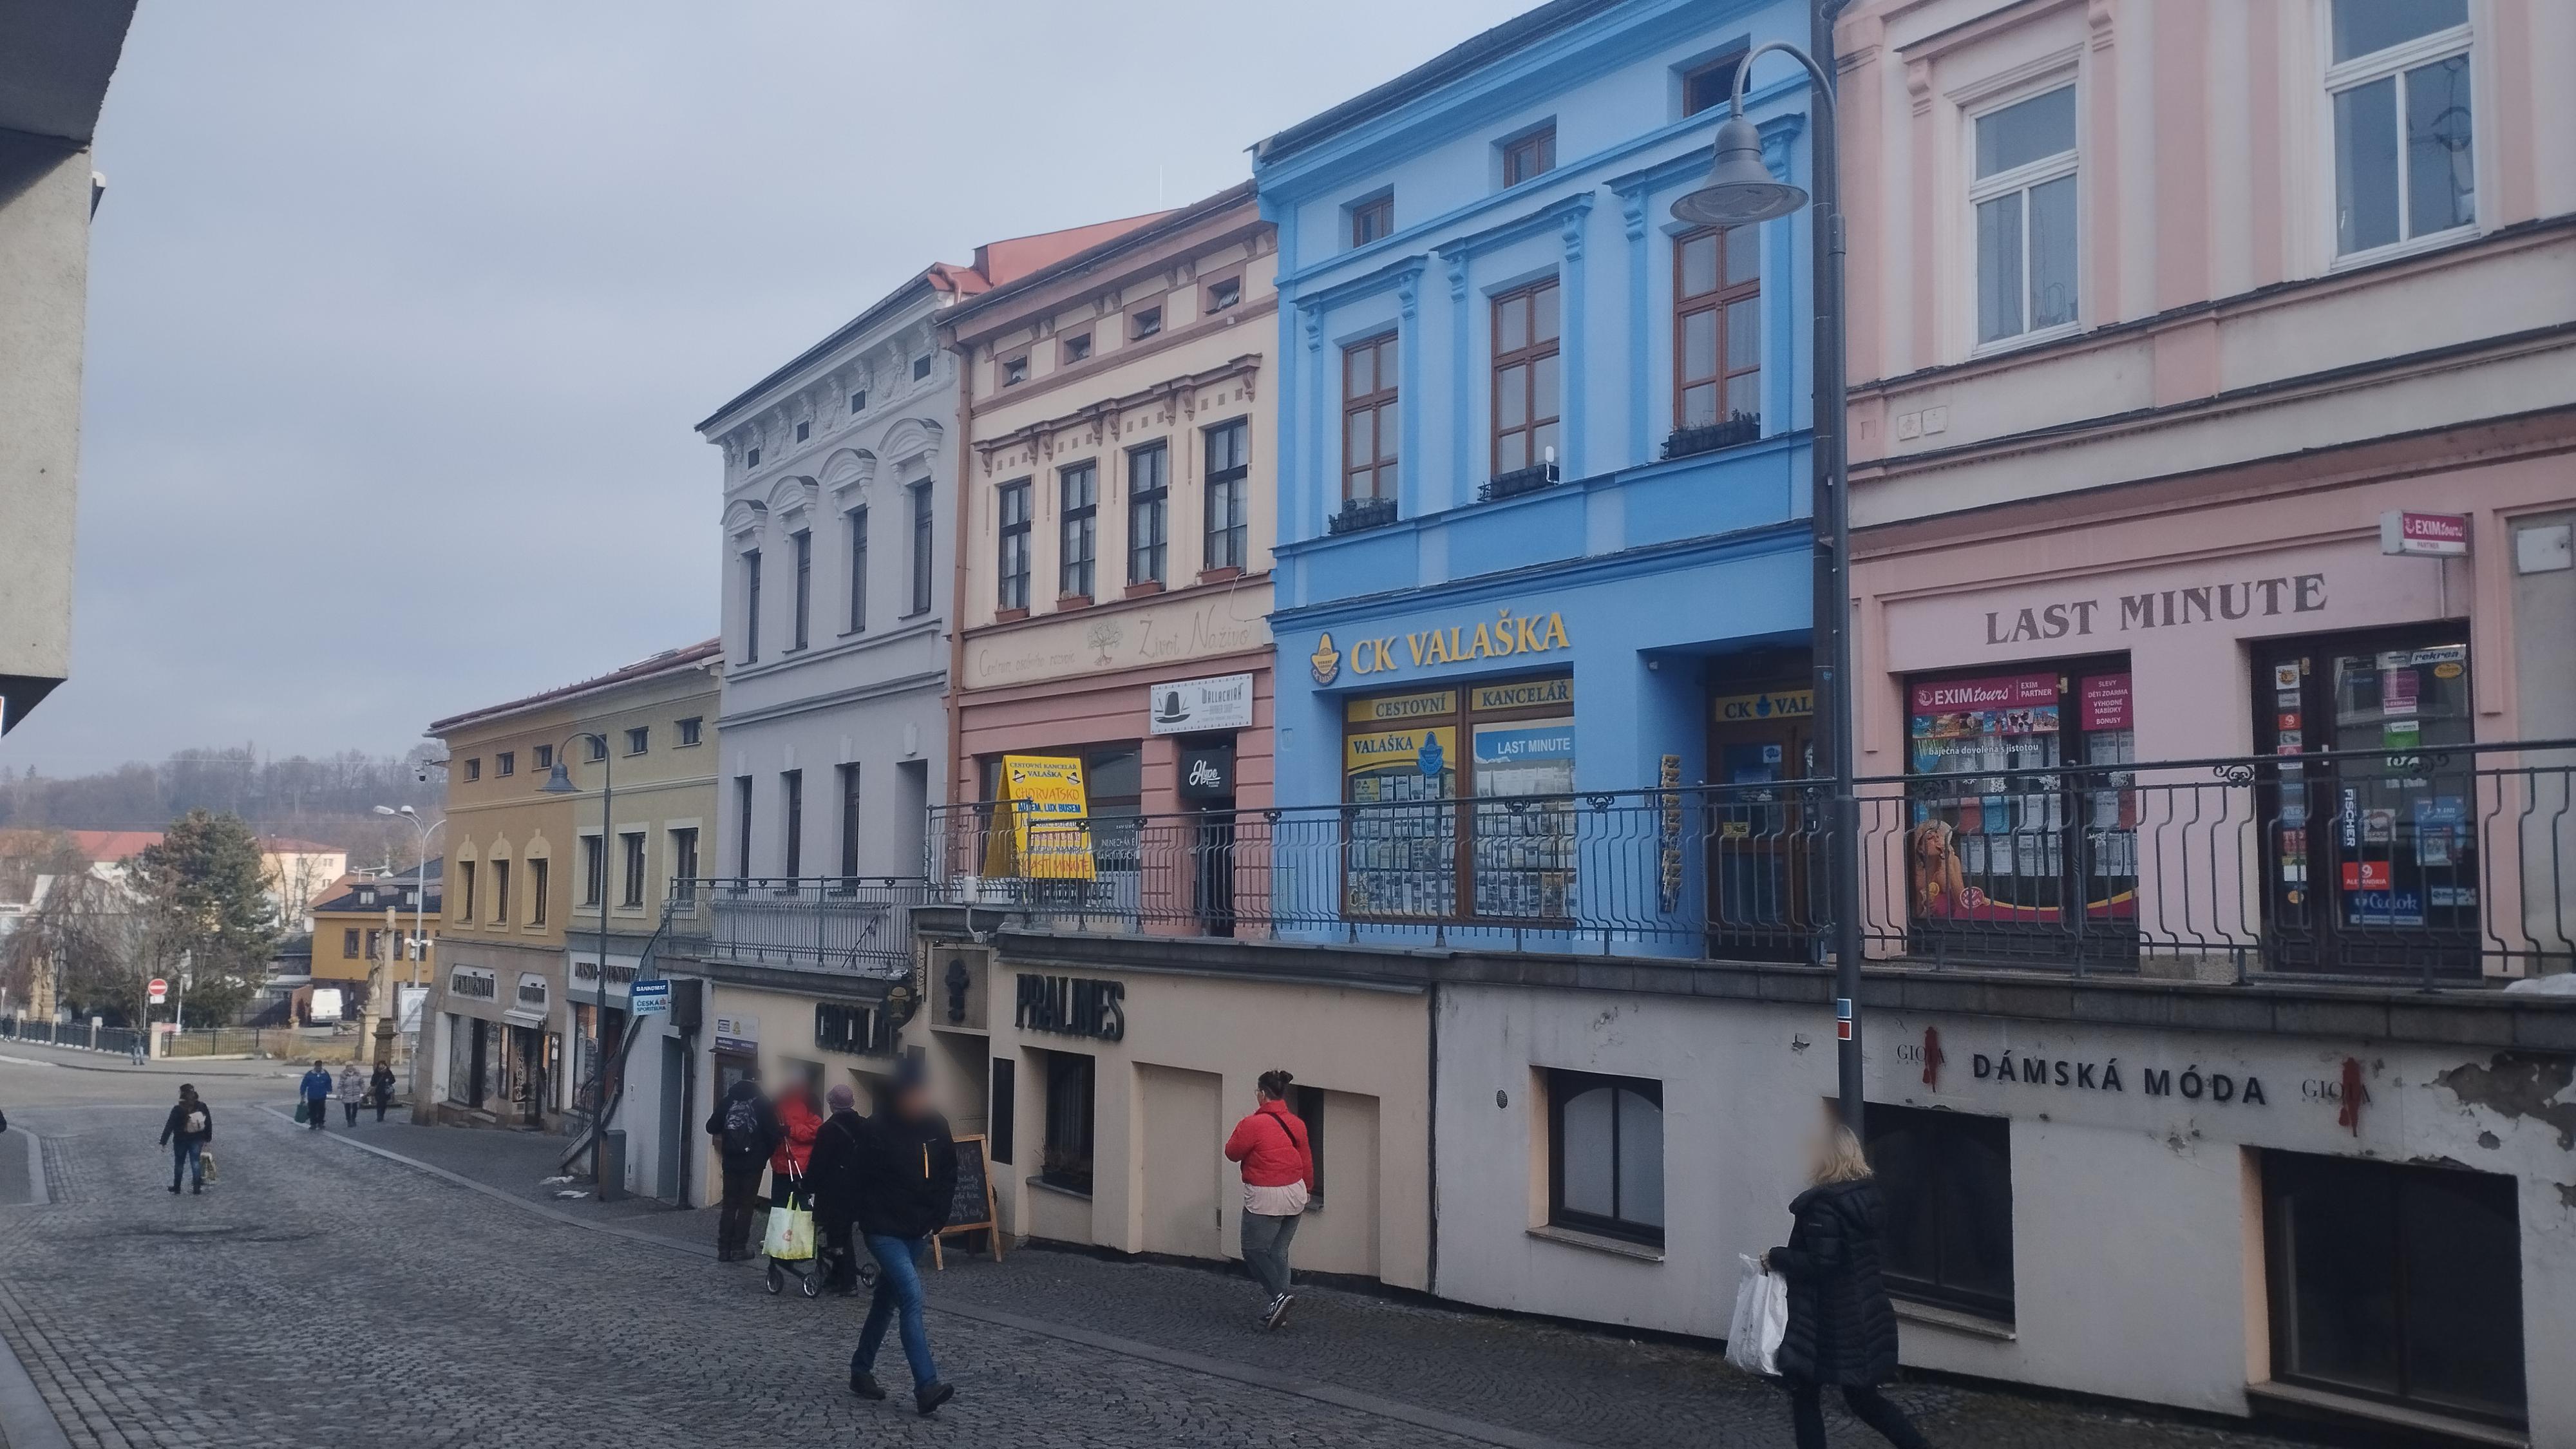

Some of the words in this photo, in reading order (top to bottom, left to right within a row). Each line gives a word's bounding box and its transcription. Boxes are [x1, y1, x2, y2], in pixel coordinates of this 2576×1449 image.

[1985, 600, 2099, 645] LAST
[2119, 573, 2328, 631] MINUTE
[1139, 614, 1180, 658] Život
[1351, 636, 1398, 674] CK
[1406, 608, 1571, 667] VALAŠKA
[1376, 692, 1446, 717] CESTOVNÍ
[1482, 679, 1569, 707] KANCELÁŘ
[1935, 687, 2009, 706] EXIMtours
[2021, 681, 2038, 690] EXIM
[2021, 688, 2052, 698] PARTNER
[2102, 688, 2128, 697] ZDARMA
[1725, 701, 1752, 719] CK
[2095, 706, 2122, 715] NABÍDKY
[2096, 717, 2121, 725] BONUSY
[1354, 734, 1414, 754] VALAŠKA
[1498, 741, 1525, 754] LAST
[1528, 737, 1571, 753] MINUTE
[2005, 743, 2040, 754] jistotou
[1016, 787, 1079, 801] CHORVATSKO
[1045, 803, 1057, 812] LUX
[1058, 804, 1081, 813] BUSEM
[2345, 789, 2356, 847] FISCHER
[1973, 1050, 2123, 1092] DÁMSKÁ
[2144, 1065, 2266, 1105] MÓDA
